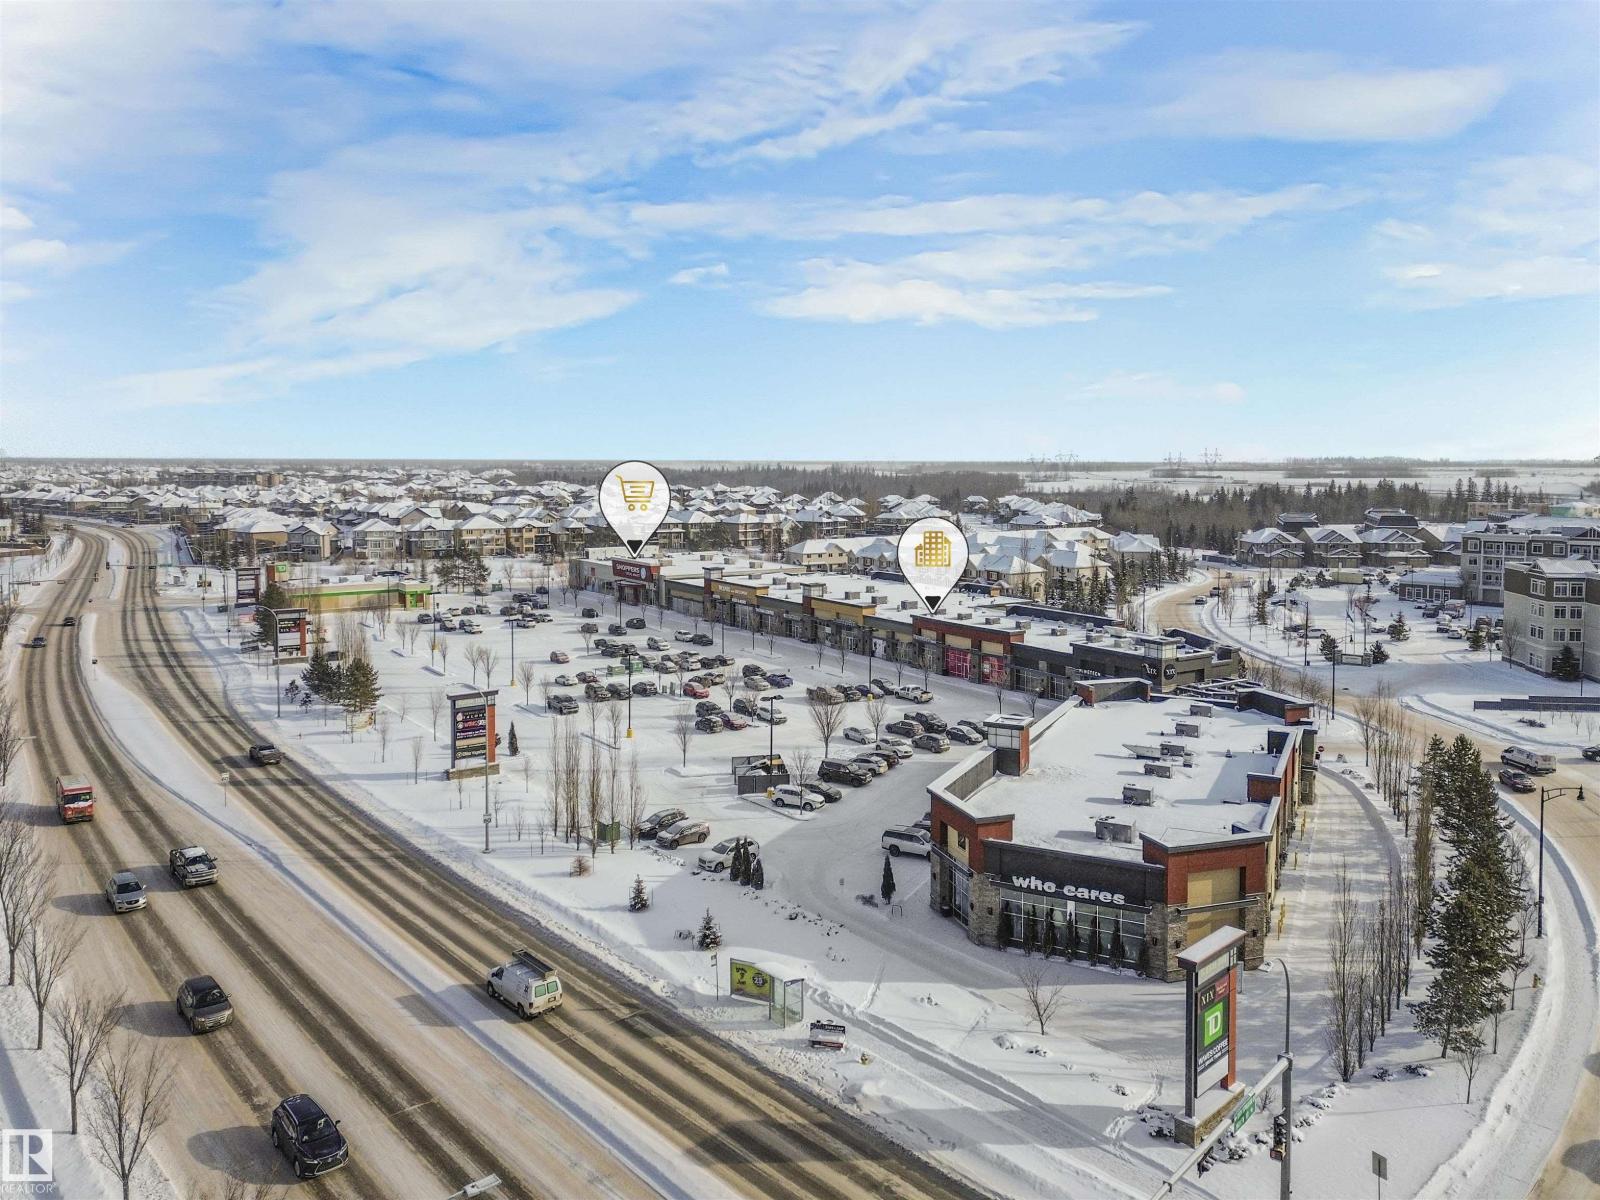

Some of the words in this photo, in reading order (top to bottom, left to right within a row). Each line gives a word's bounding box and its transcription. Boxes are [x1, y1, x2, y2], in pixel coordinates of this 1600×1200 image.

[615, 563, 640, 574] SHOPPERS
[1012, 875, 1057, 893] who
[1063, 885, 1125, 905] cares
[1201, 989, 1214, 1006] XIX
[1206, 1011, 1221, 1036] TD
[1212, 1038, 1228, 1055] COFFEE
